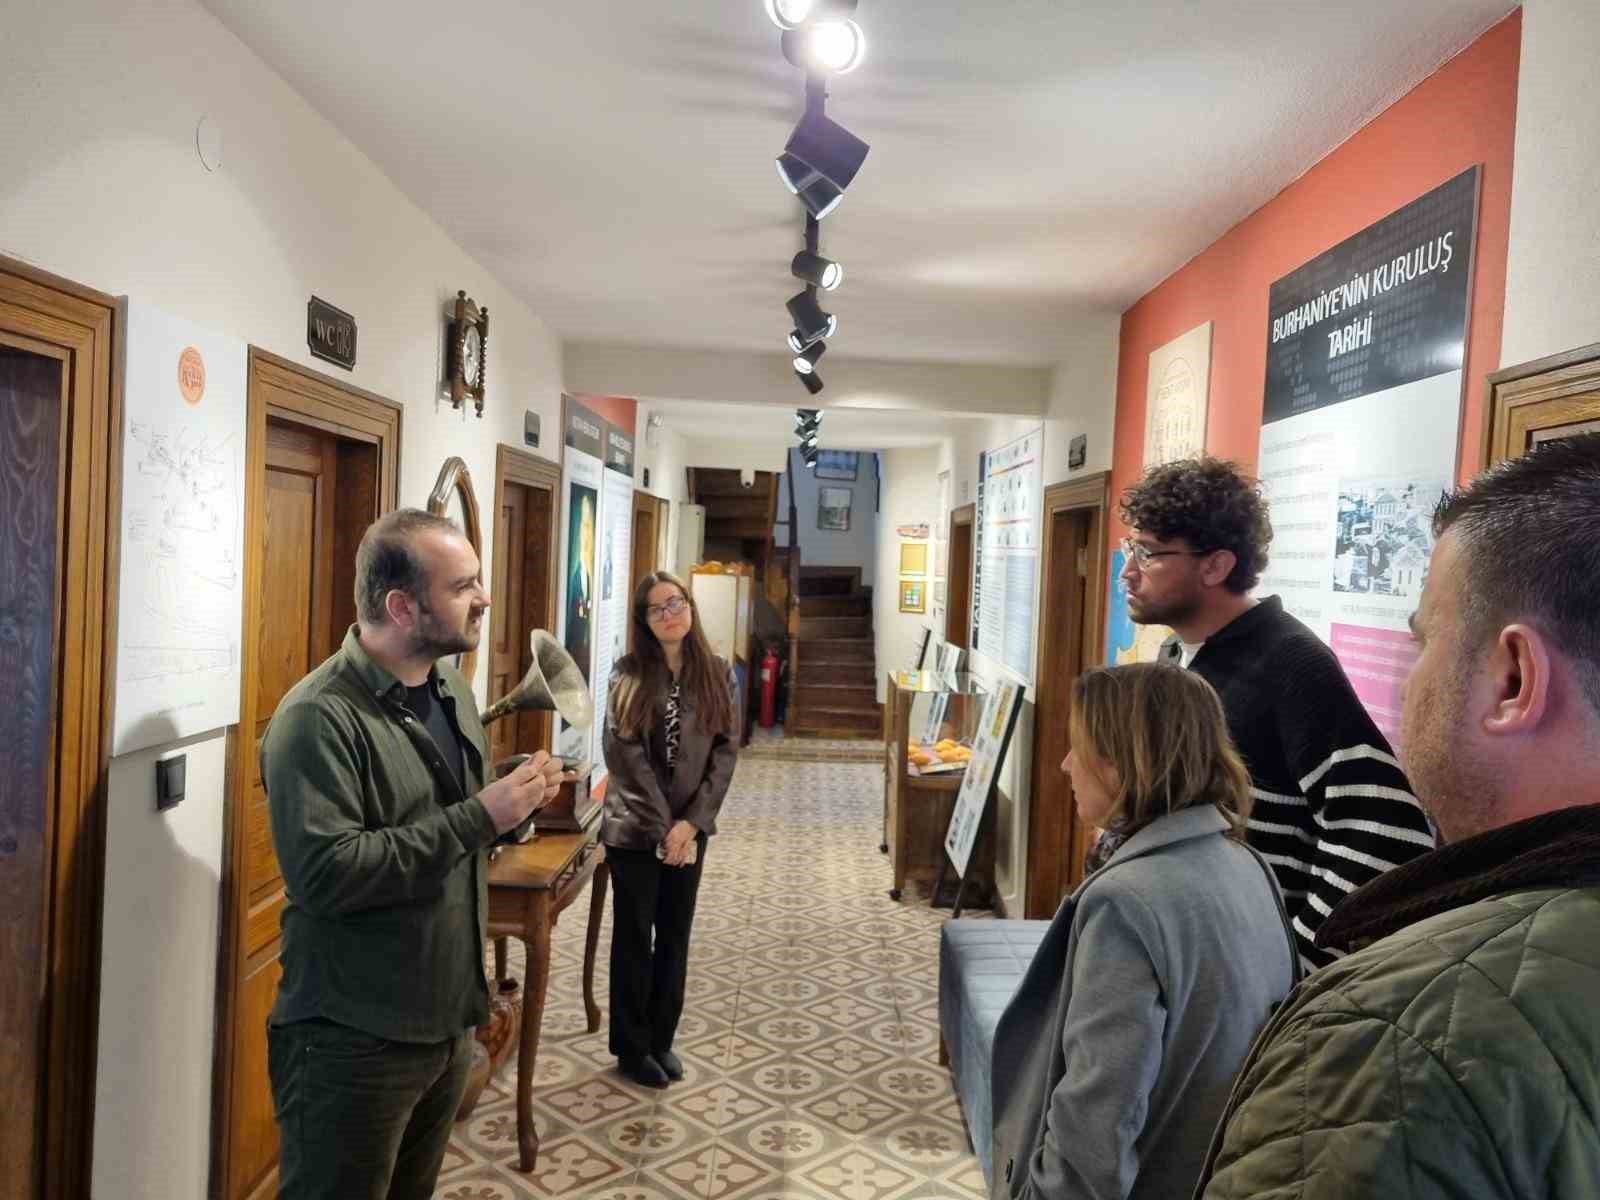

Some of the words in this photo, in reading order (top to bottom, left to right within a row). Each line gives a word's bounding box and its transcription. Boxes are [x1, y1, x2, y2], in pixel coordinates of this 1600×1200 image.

[1272, 272, 1370, 343] BURHANİYE'NİN
[1373, 231, 1453, 296] KURULUŞ
[315, 318, 336, 346] WC
[1328, 310, 1373, 358] TARİHİ
